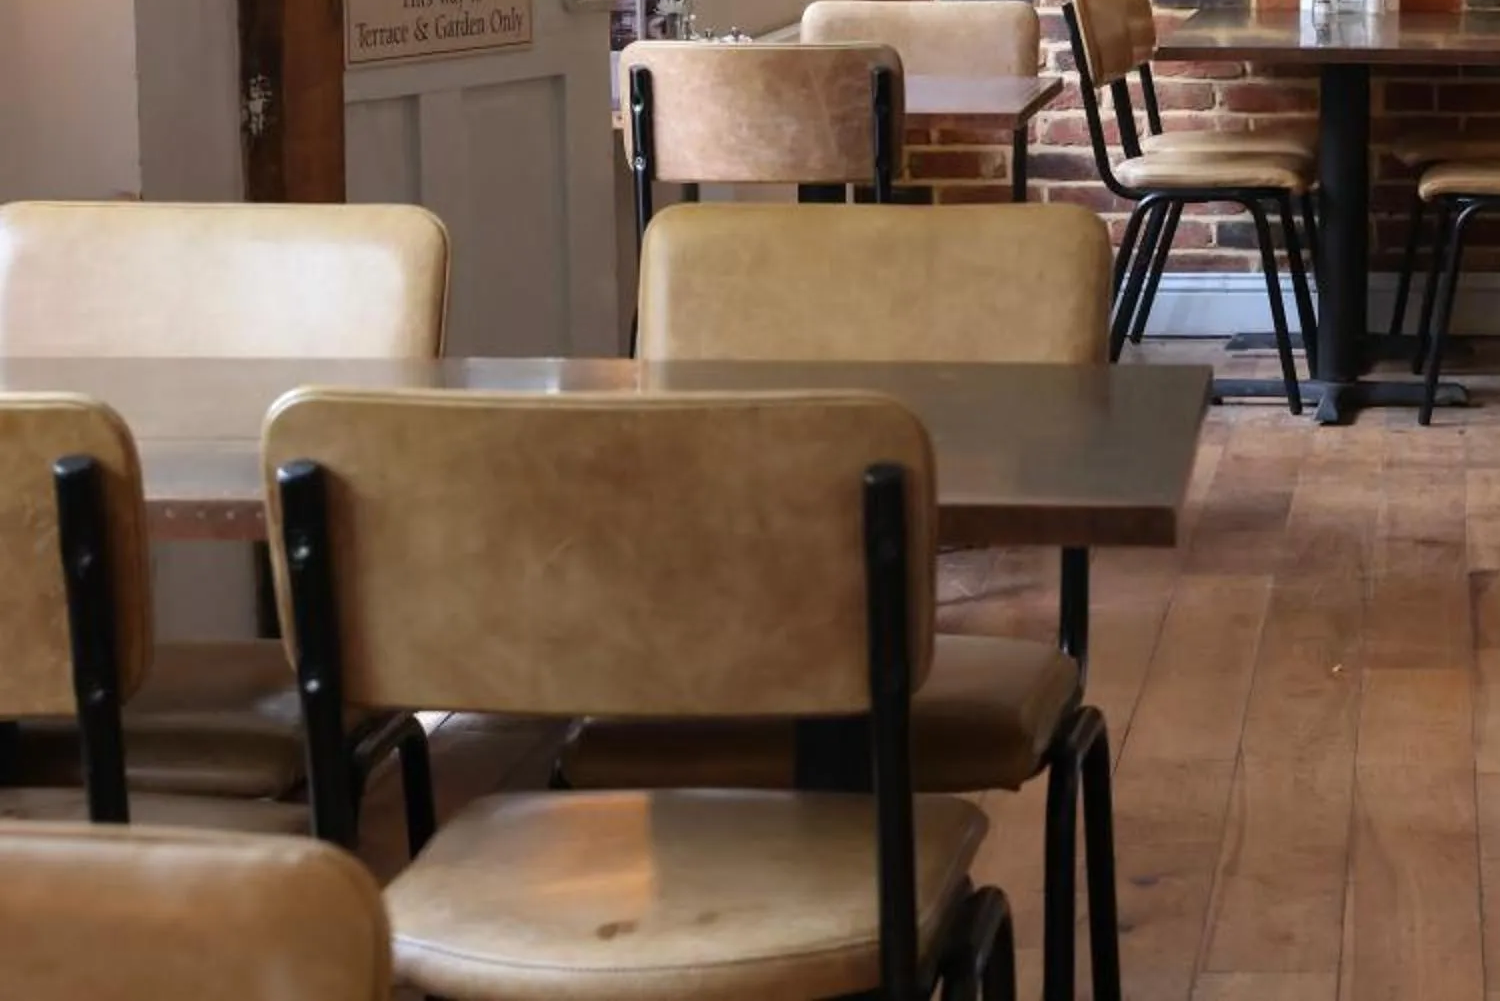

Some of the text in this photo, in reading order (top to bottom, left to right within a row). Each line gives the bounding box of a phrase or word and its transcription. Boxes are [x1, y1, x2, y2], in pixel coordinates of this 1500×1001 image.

[354, 6, 524, 49] Terrace & Garden Only
